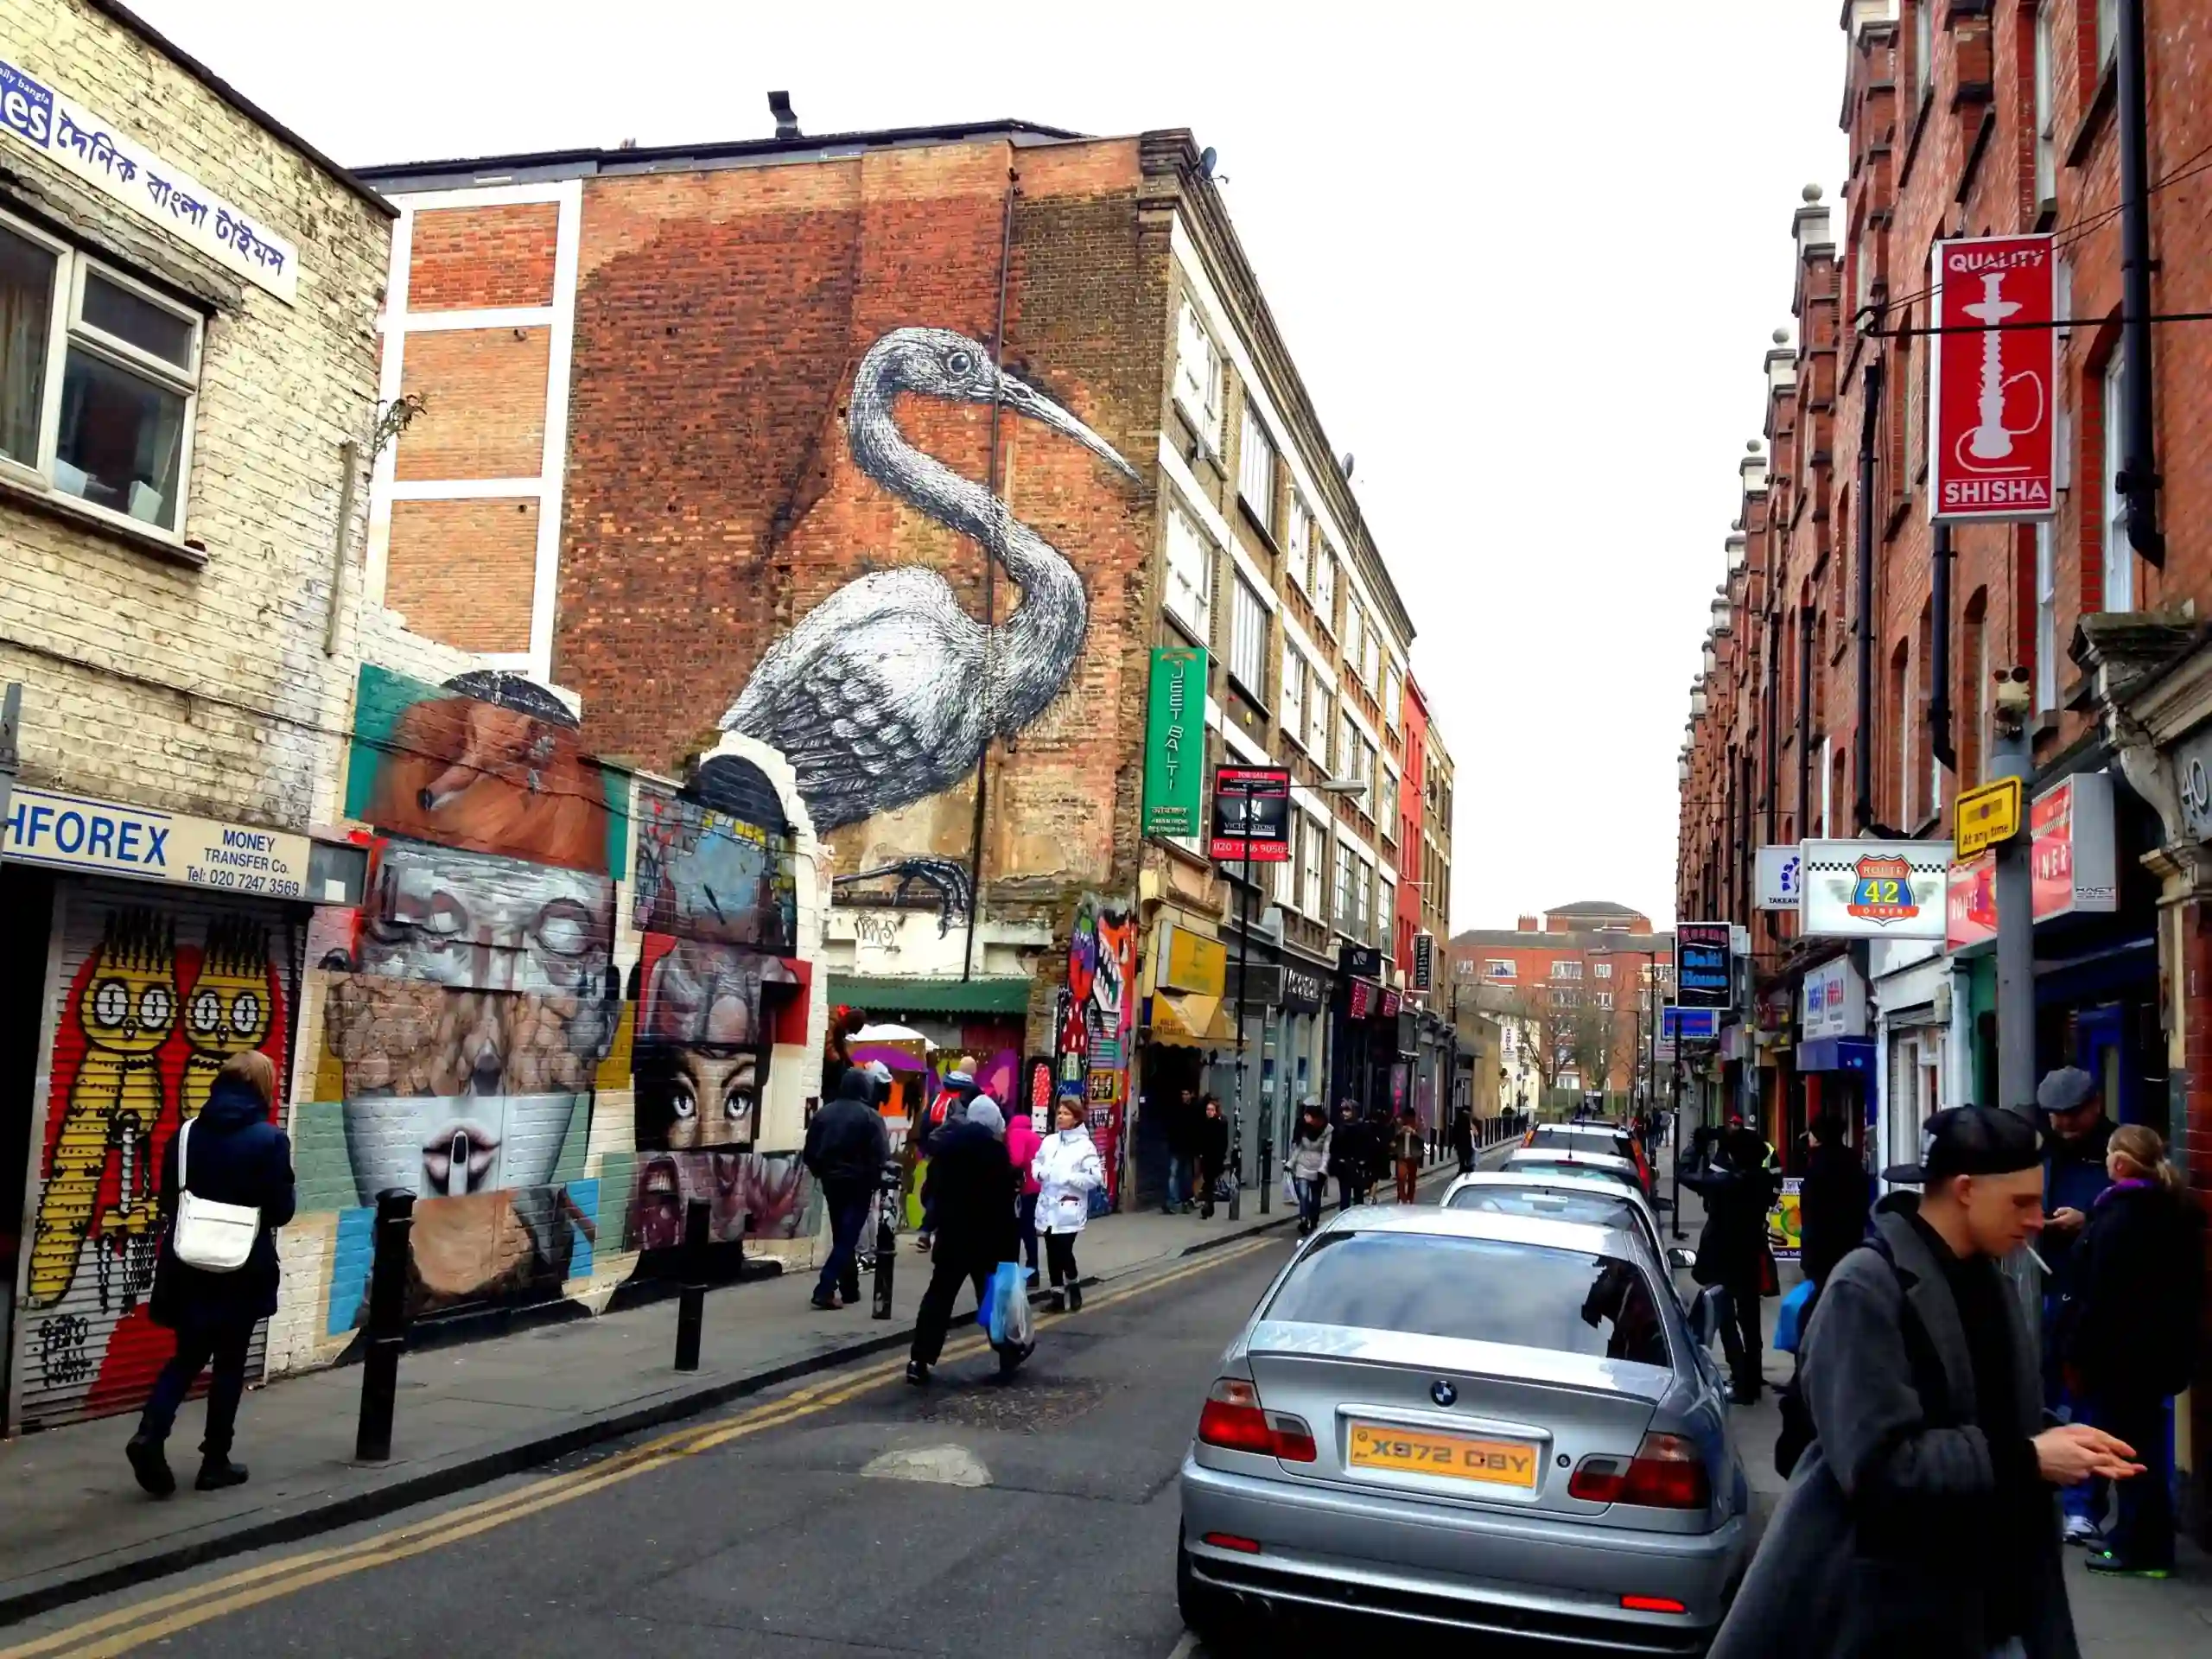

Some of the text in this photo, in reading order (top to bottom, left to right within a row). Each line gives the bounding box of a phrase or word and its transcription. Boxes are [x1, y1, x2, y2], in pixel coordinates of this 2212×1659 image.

[0, 68, 50, 105] aily bangla
[0, 85, 48, 140] es
[147, 171, 209, 229] বাংলা
[1948, 250, 2045, 273] QUALITY
[1944, 480, 2048, 504] SHISHA
[1165, 725, 1185, 791] BALTI
[2183, 757, 2208, 811] 40
[1224, 822, 1276, 830] VICTSTONE
[1963, 823, 2010, 847] At any time
[223, 829, 276, 853] MONEY
[1235, 843, 1258, 854] 716
[204, 848, 290, 874] TRANSFER Co.
[1862, 865, 1904, 876] ROUTE
[2036, 844, 2067, 883] INER
[187, 865, 300, 897] Tel: 020 7247 3569
[1864, 880, 1900, 904] 42
[1952, 887, 1979, 921] ROUTE
